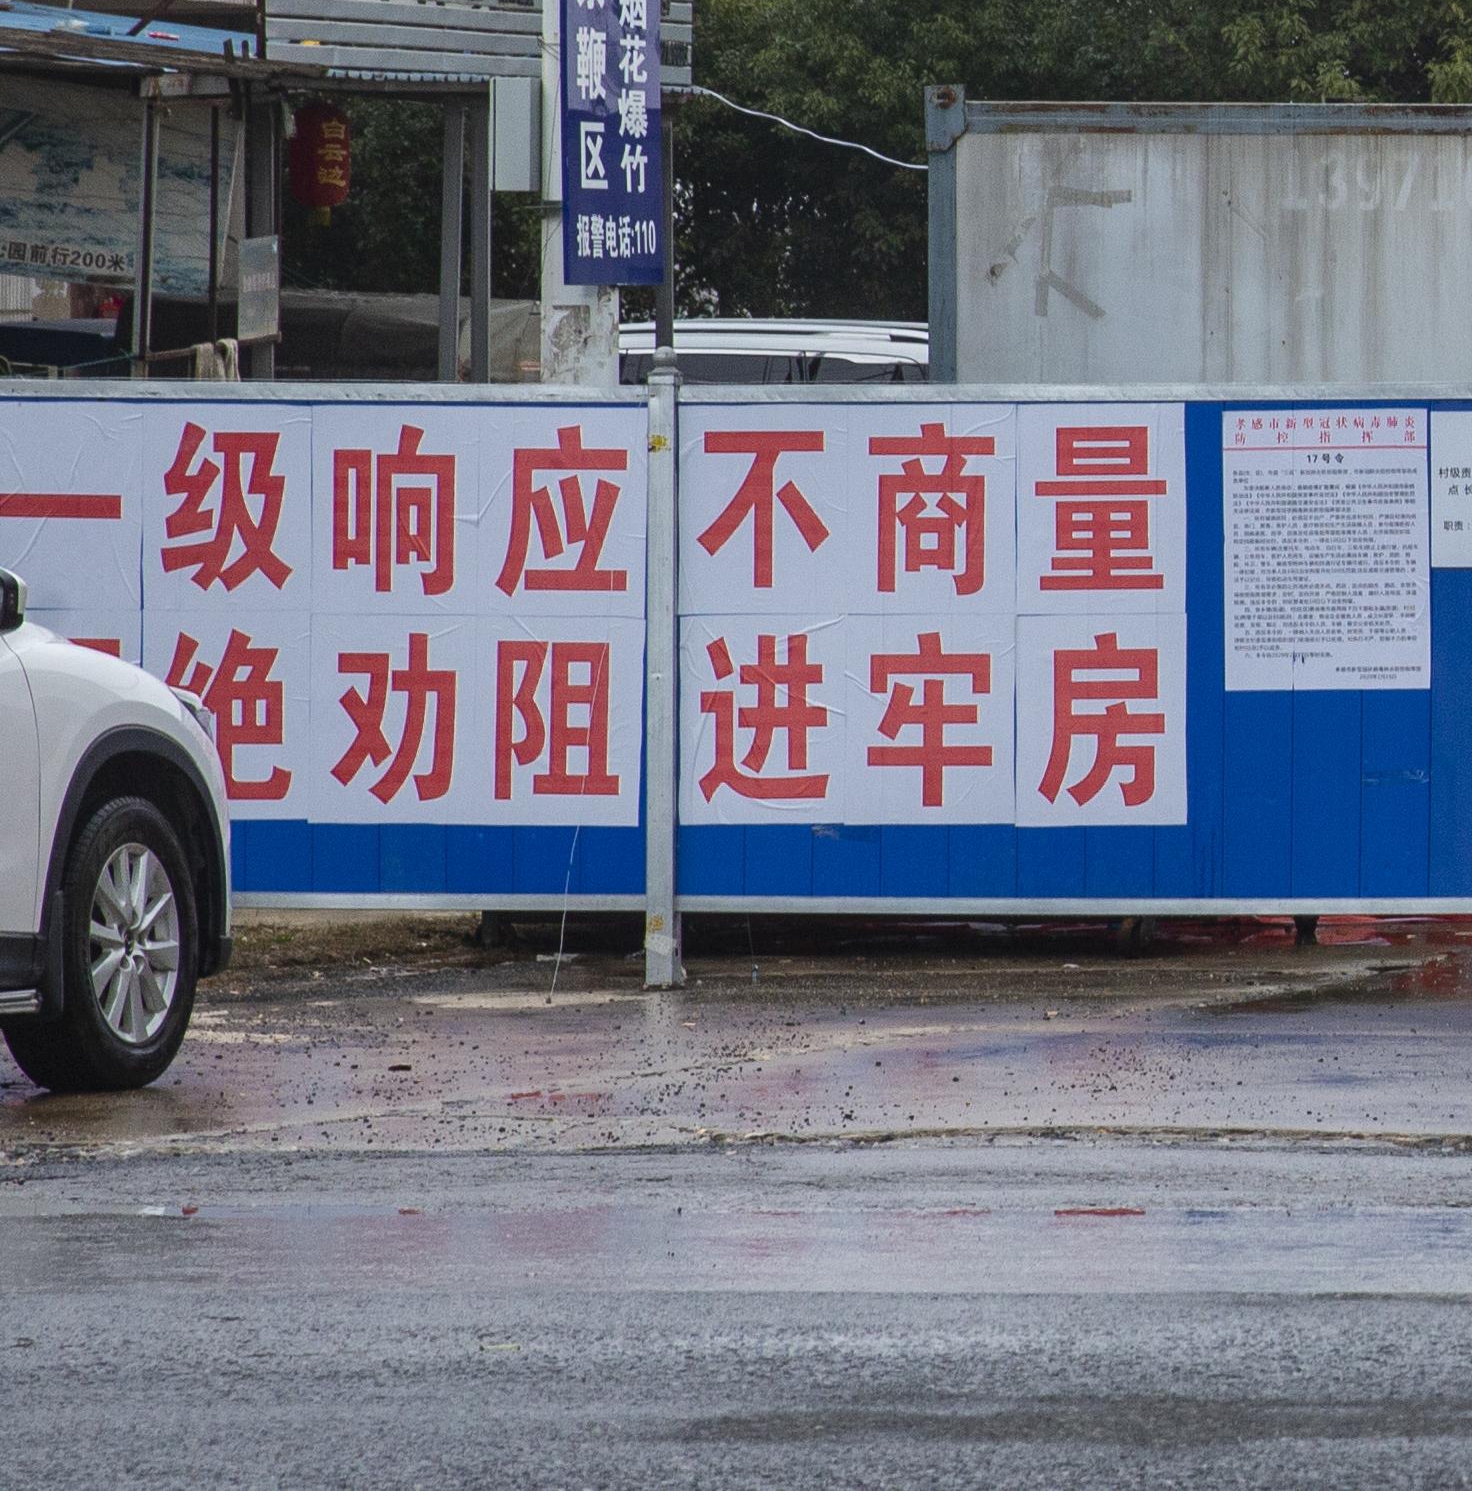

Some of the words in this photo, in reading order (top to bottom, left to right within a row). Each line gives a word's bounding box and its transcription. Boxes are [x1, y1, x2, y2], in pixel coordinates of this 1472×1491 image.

[576, 213, 657, 259] 报警电话:110
[1235, 415, 1416, 430] 孝感市新型冠状病毒肺炎
[1235, 431, 1416, 445] 防控指挥部
[0, 421, 628, 597] 一级响应
[696, 423, 1167, 596] 不商量
[697, 631, 1166, 808] 进牢房
